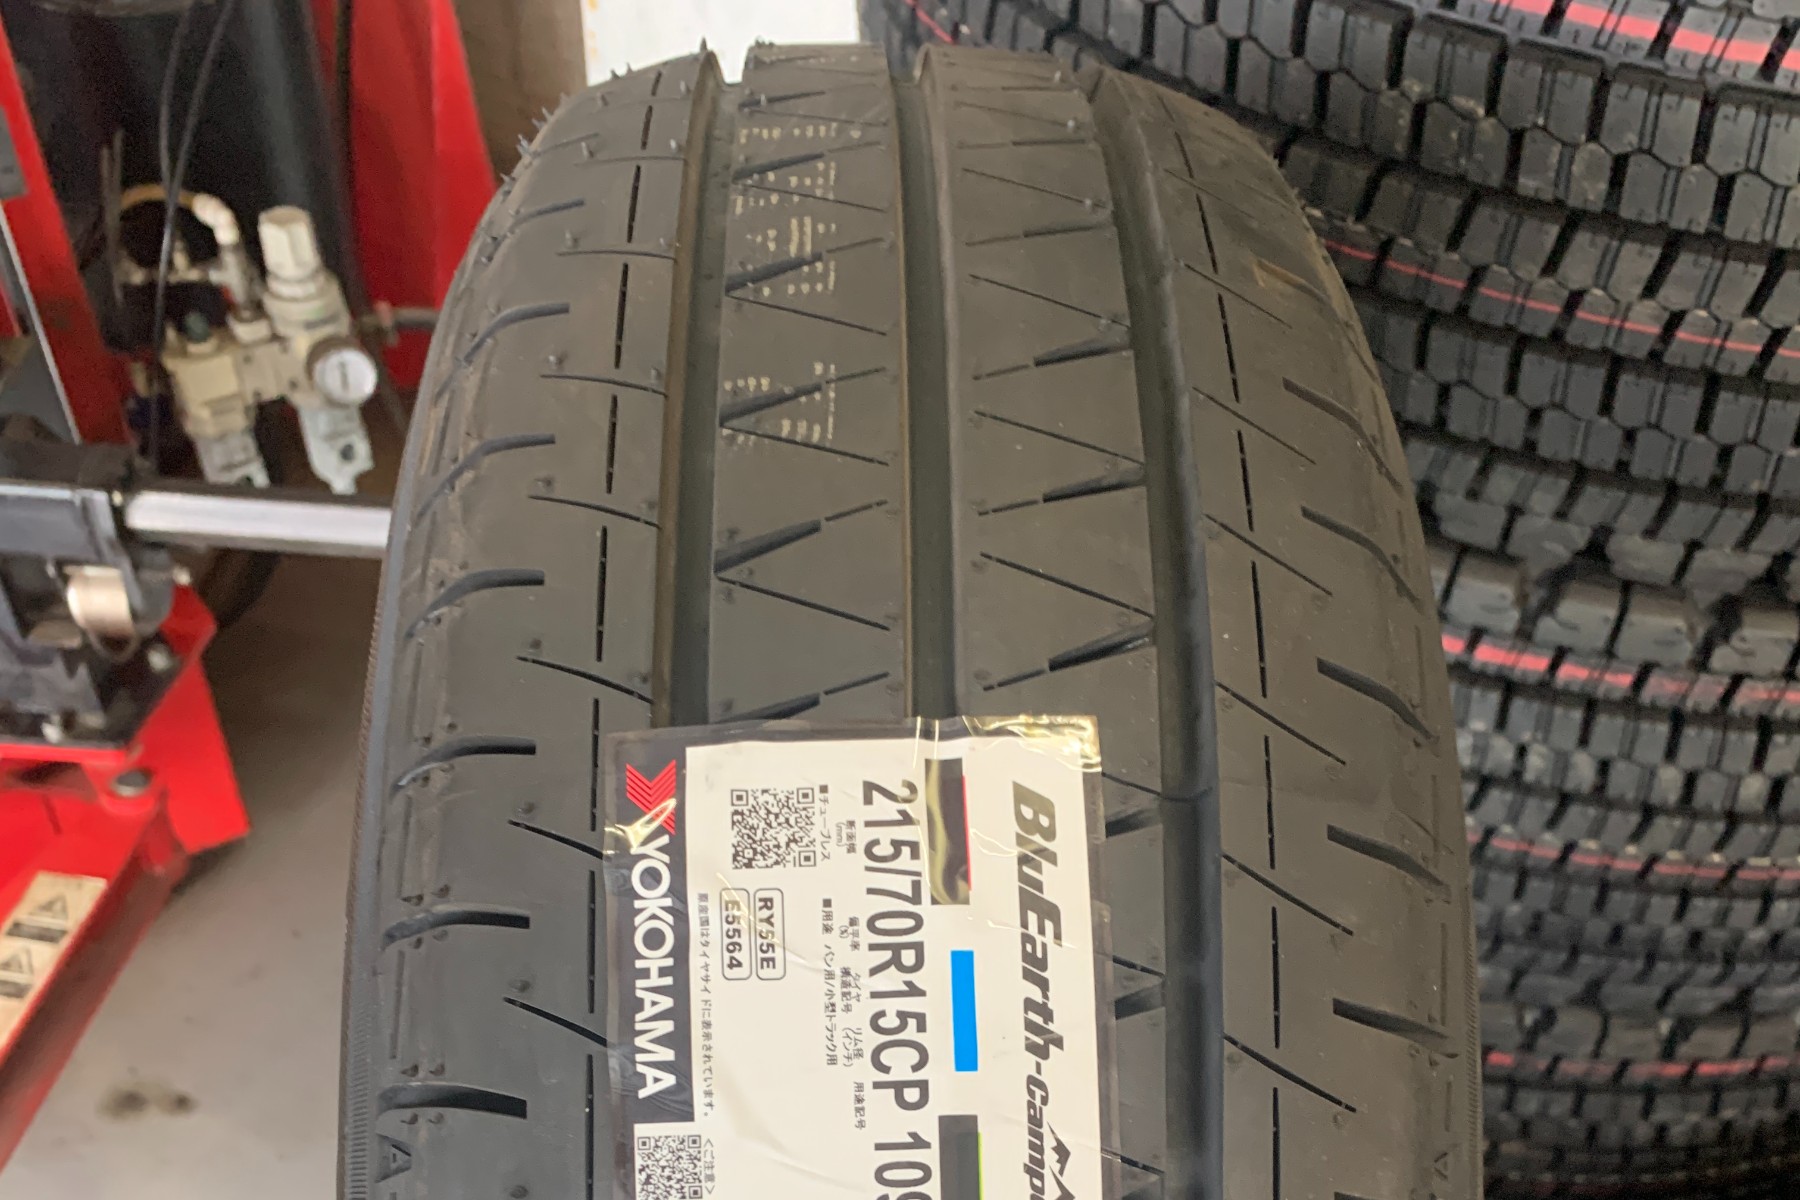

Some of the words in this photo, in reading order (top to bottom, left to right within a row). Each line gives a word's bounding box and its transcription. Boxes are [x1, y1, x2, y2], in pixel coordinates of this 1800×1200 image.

[835, 822, 846, 848] (mm)
[725, 899, 744, 971] E5564
[757, 897, 776, 971] RY55E
[862, 779, 929, 1111] 215/70R15CP
[629, 834, 677, 1099] YOKOHAMA
[851, 973, 862, 1002] タイヤ
[852, 1027, 864, 1060] リム径
[854, 1081, 865, 1130] 用途記号
